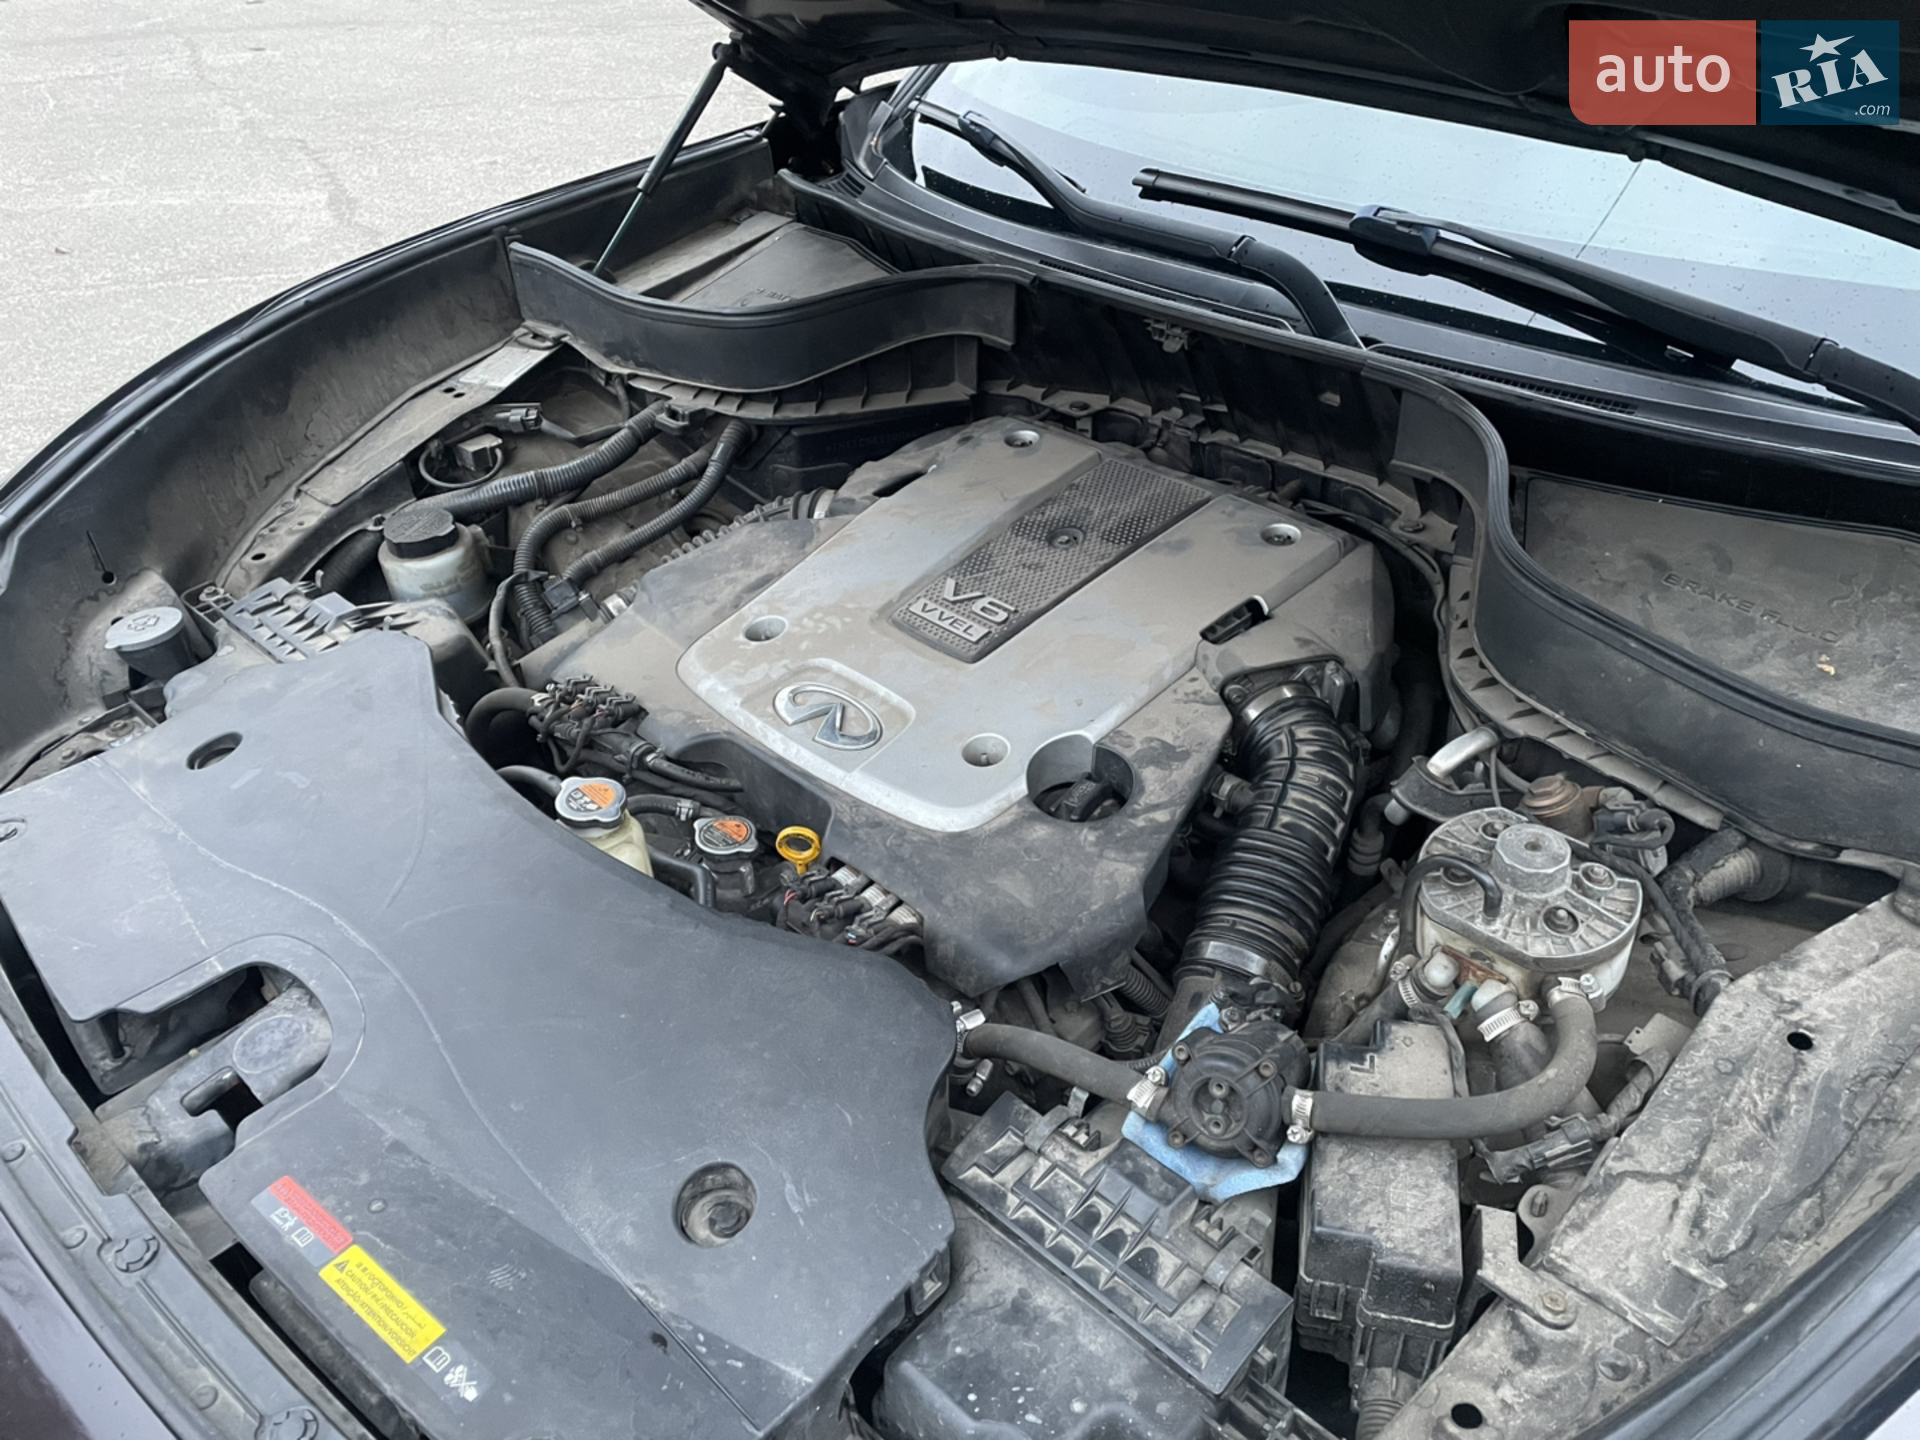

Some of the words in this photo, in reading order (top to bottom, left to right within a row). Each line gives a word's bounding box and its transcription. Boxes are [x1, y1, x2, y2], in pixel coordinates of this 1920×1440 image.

[943, 578, 1017, 624] V6
[1662, 573, 1755, 613] BRAKE
[920, 602, 975, 637] VVEL
